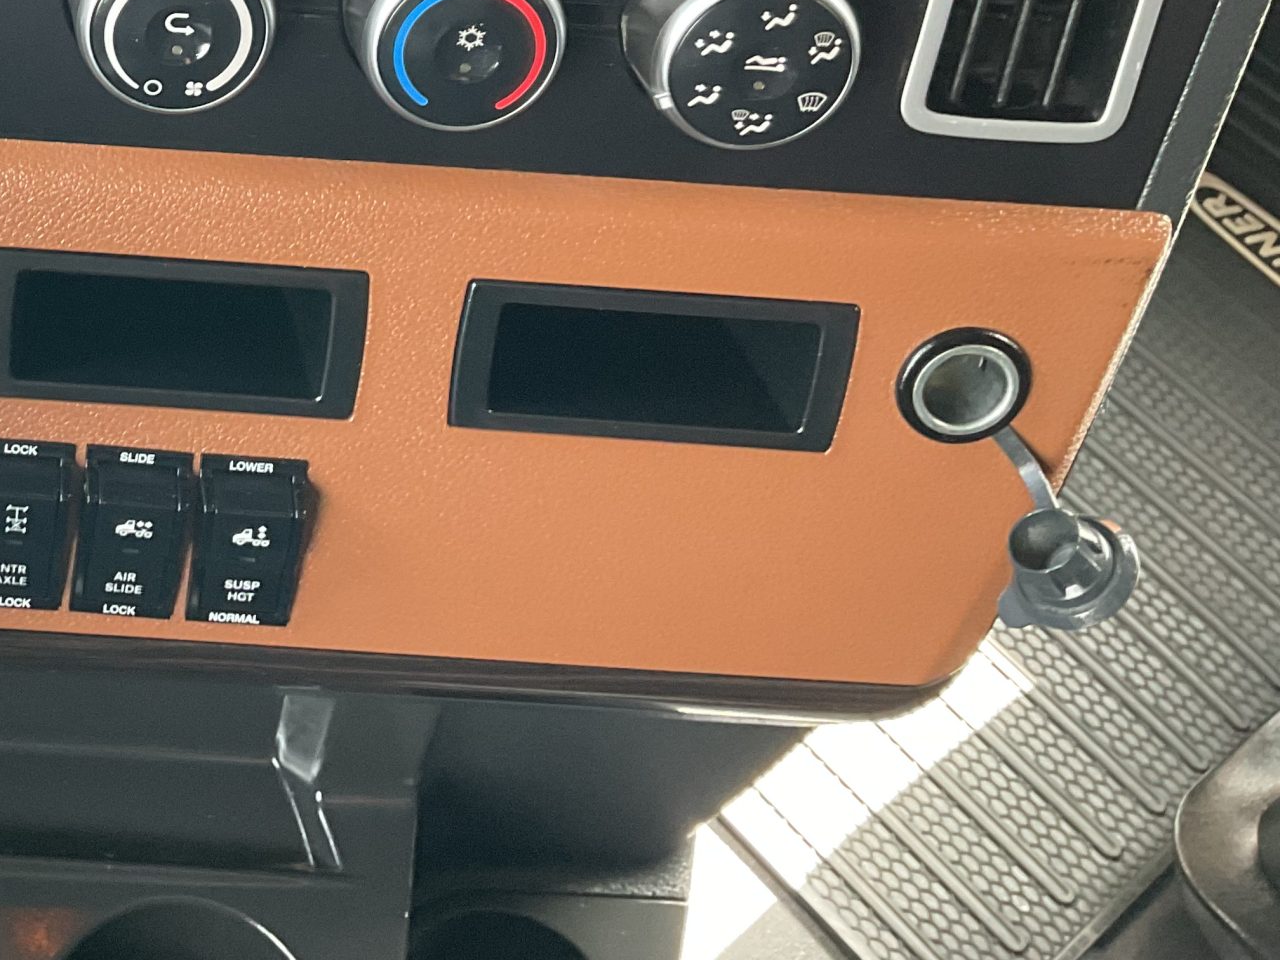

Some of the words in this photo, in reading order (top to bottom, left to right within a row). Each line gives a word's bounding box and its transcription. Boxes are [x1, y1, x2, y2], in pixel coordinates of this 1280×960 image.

[3, 443, 38, 456] LOCK
[120, 451, 155, 465] SLIDE
[229, 460, 274, 474] LOWER
[113, 571, 137, 583] AIR
[104, 582, 143, 595] SLIDE
[224, 579, 261, 590] SUSP
[102, 603, 136, 616] LOCK
[208, 611, 260, 625] NORMAL
